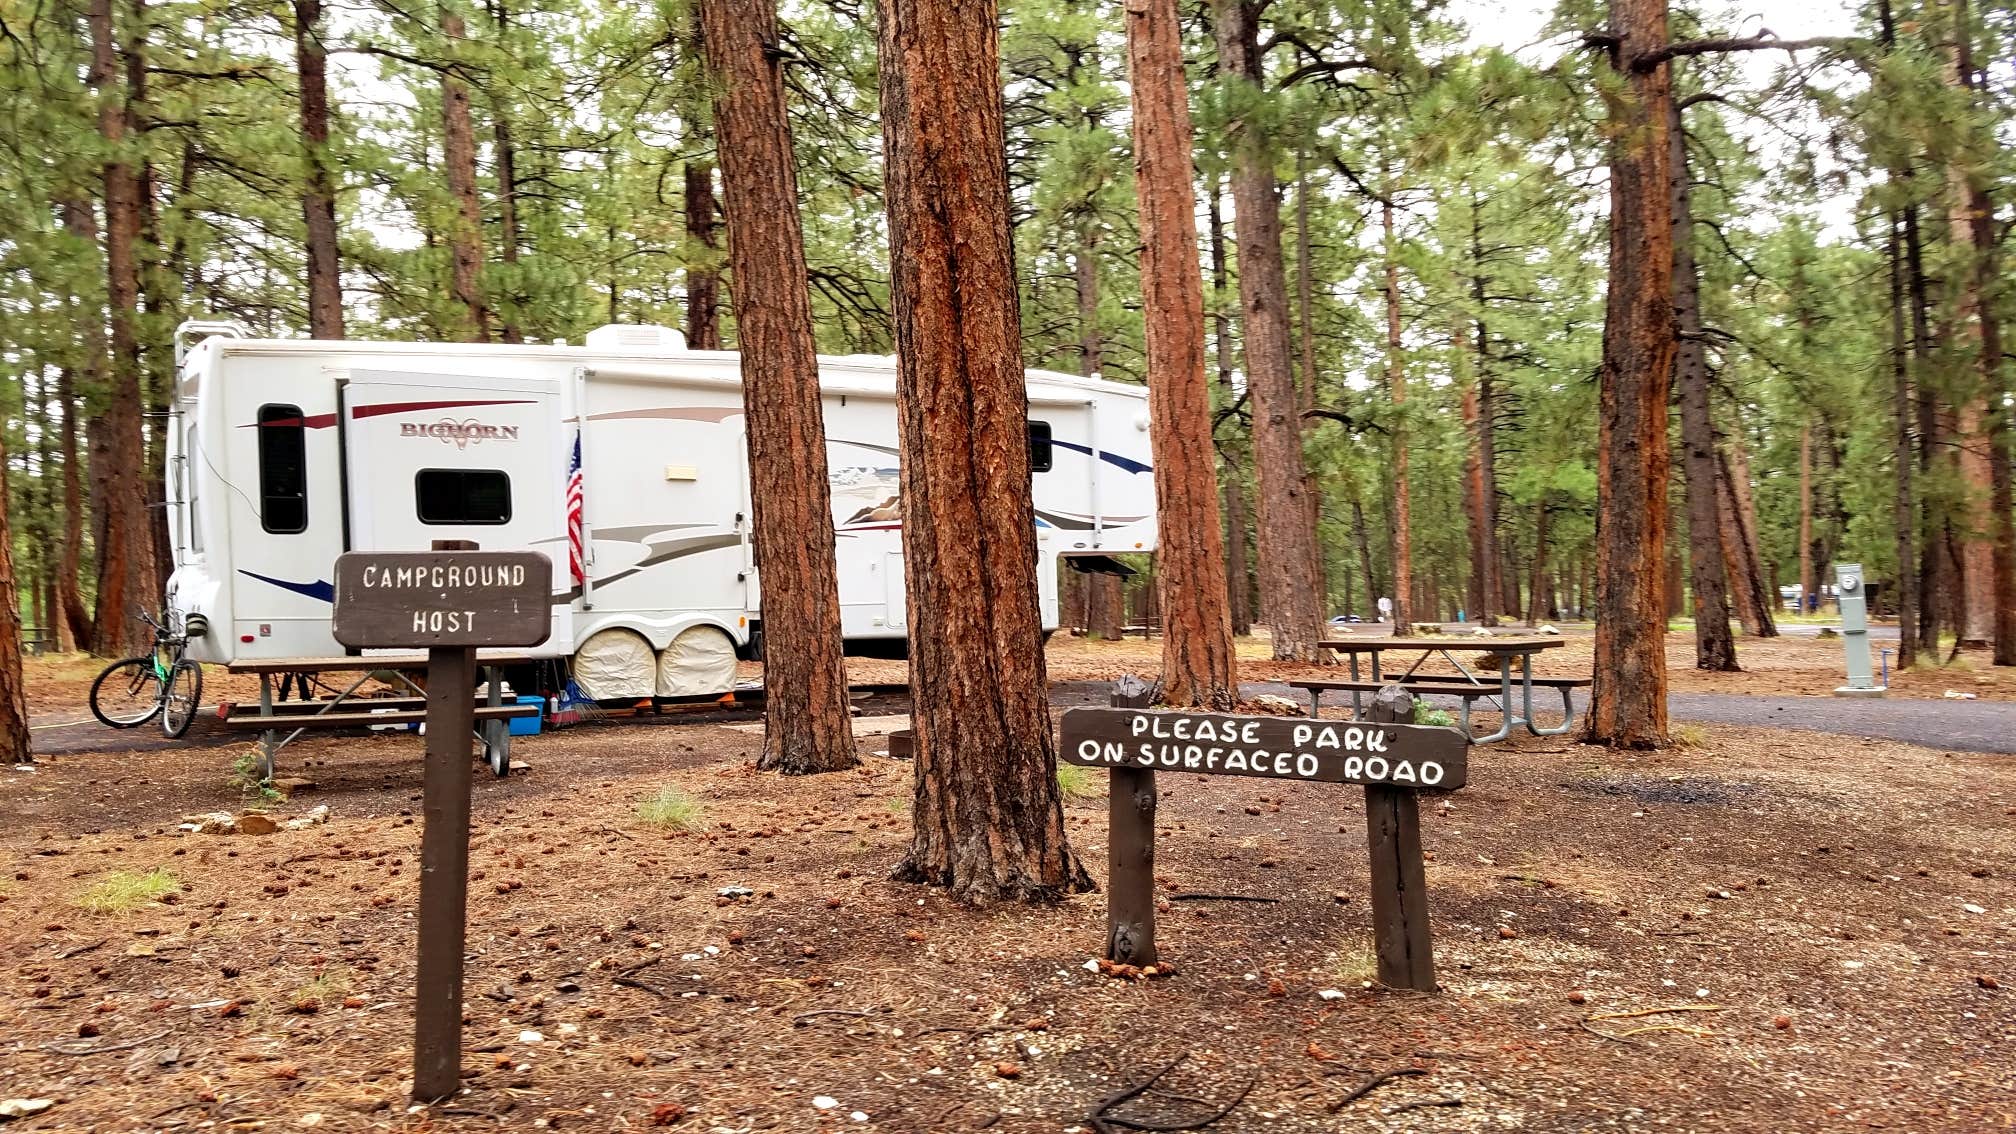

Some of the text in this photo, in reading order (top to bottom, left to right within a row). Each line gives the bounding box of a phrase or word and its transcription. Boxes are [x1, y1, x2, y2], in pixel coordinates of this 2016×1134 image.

[400, 422, 519, 440] BIGHORN
[363, 564, 525, 588] CAMPGROUND
[413, 611, 476, 633] HOST
[1132, 715, 1388, 752] PLEASE PARK
[1078, 739, 1444, 785] ON SURFACED ROAD
